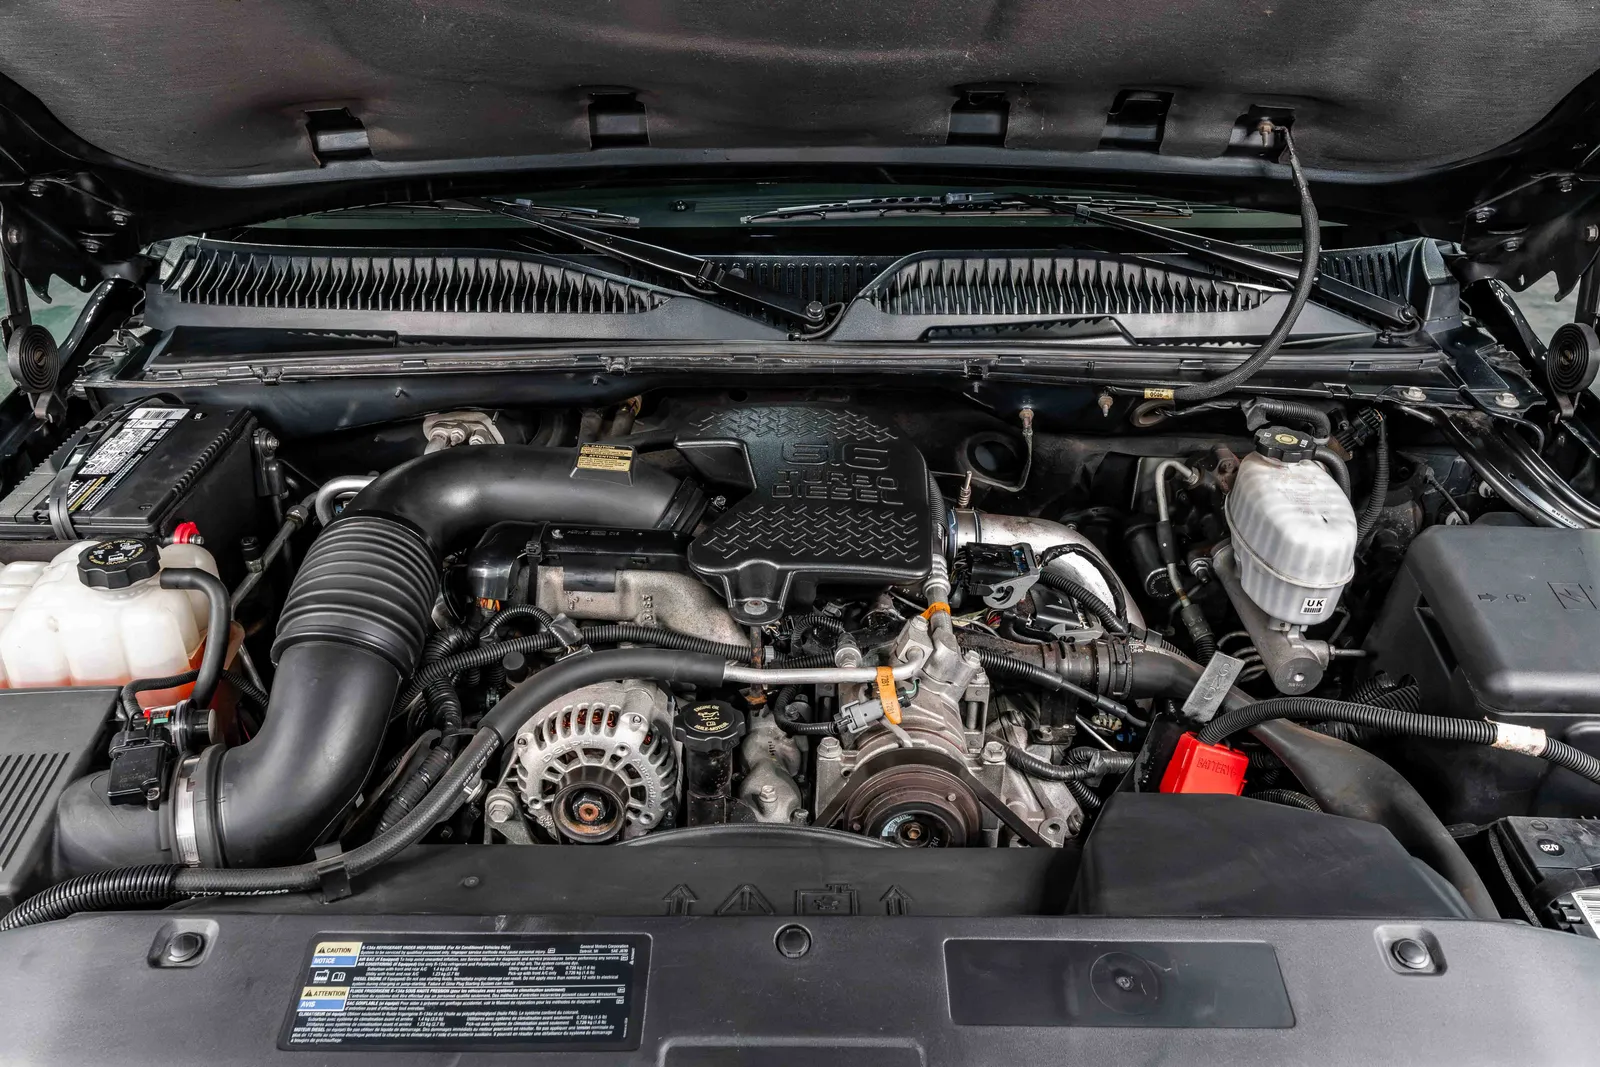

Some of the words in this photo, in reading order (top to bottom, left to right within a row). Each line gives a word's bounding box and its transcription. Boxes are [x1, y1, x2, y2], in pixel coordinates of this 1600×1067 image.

[782, 441, 890, 470] 6.6
[777, 469, 898, 490] TURBO
[772, 484, 904, 505] DIESEL
[1196, 758, 1232, 776] BATTERY
